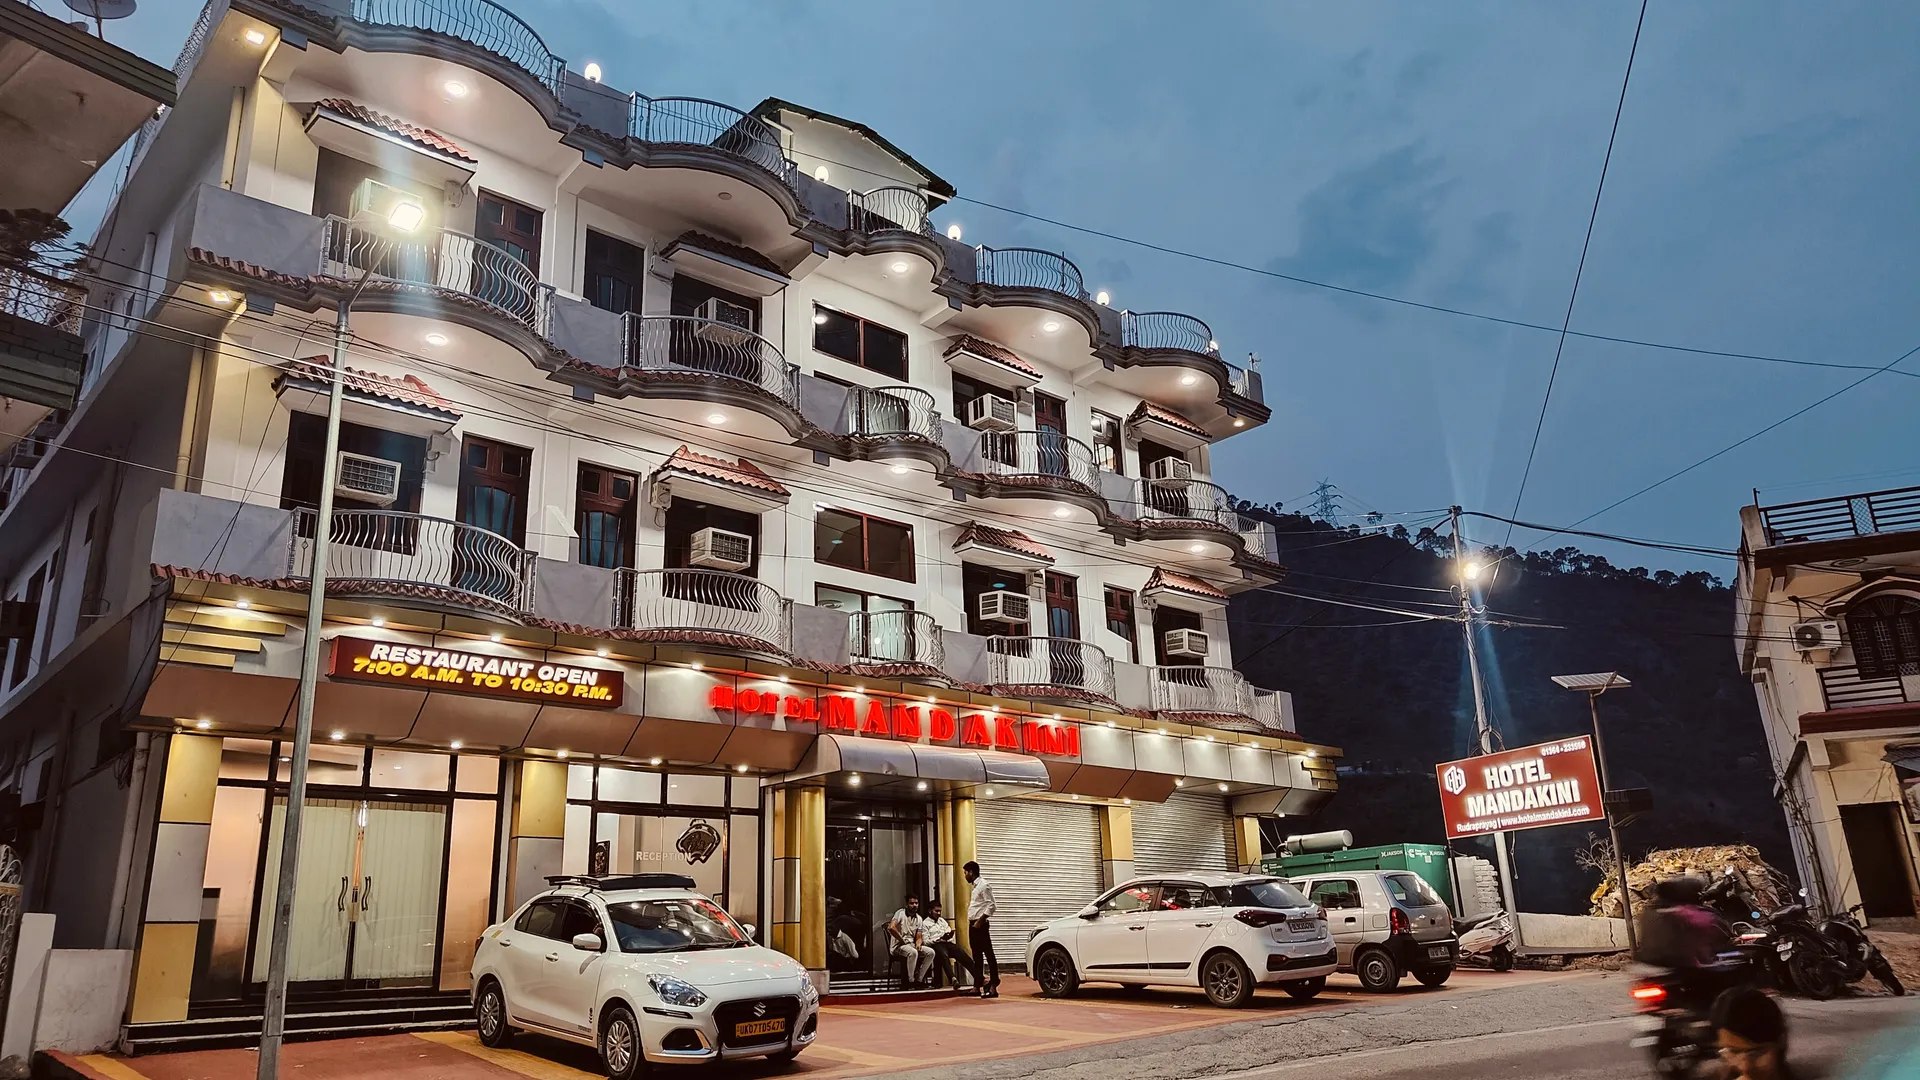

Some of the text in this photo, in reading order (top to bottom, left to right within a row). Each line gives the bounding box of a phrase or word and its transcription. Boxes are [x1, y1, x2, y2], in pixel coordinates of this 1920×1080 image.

[352, 657, 613, 701] 7:00 A.M. TO 10:30 P.M.
[370, 643, 598, 686] RESTAURANT OPEN
[709, 684, 1081, 757] HOTEL MANDAKINI
[1483, 758, 1552, 790] HOTEL
[1467, 779, 1581, 818] MANDAKINI
[635, 850, 692, 862] RECEPTION
